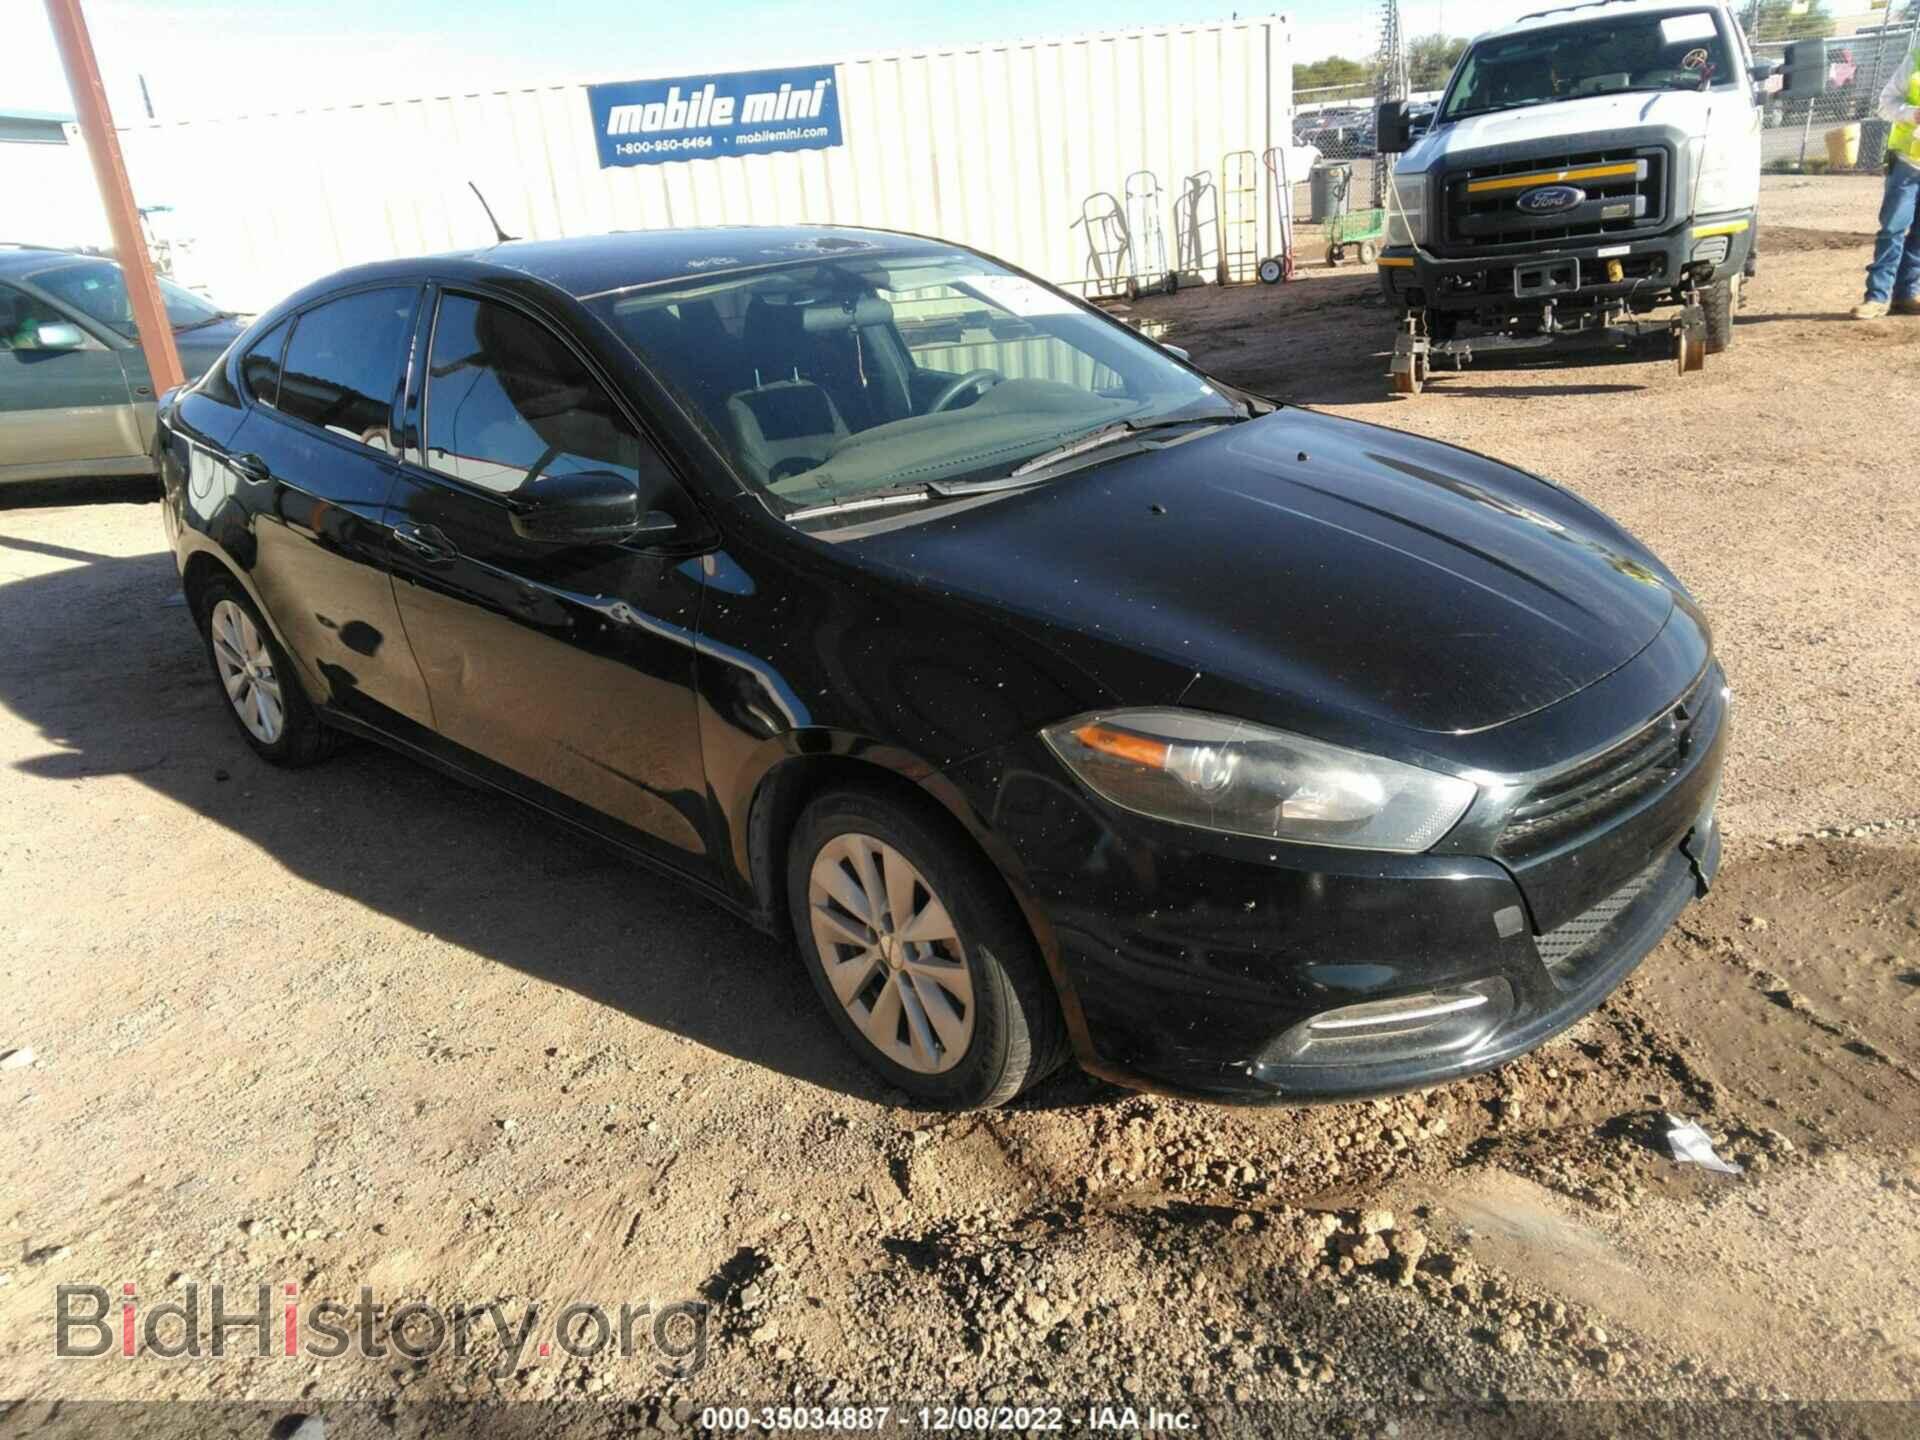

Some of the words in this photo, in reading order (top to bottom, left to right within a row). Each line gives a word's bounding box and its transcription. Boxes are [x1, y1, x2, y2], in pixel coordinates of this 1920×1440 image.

[607, 84, 735, 135] mobile
[741, 82, 825, 123] mini
[616, 135, 713, 156] 1-800-950-6464
[735, 126, 828, 145] mobilemini.com
[1530, 191, 1567, 208] Ford
